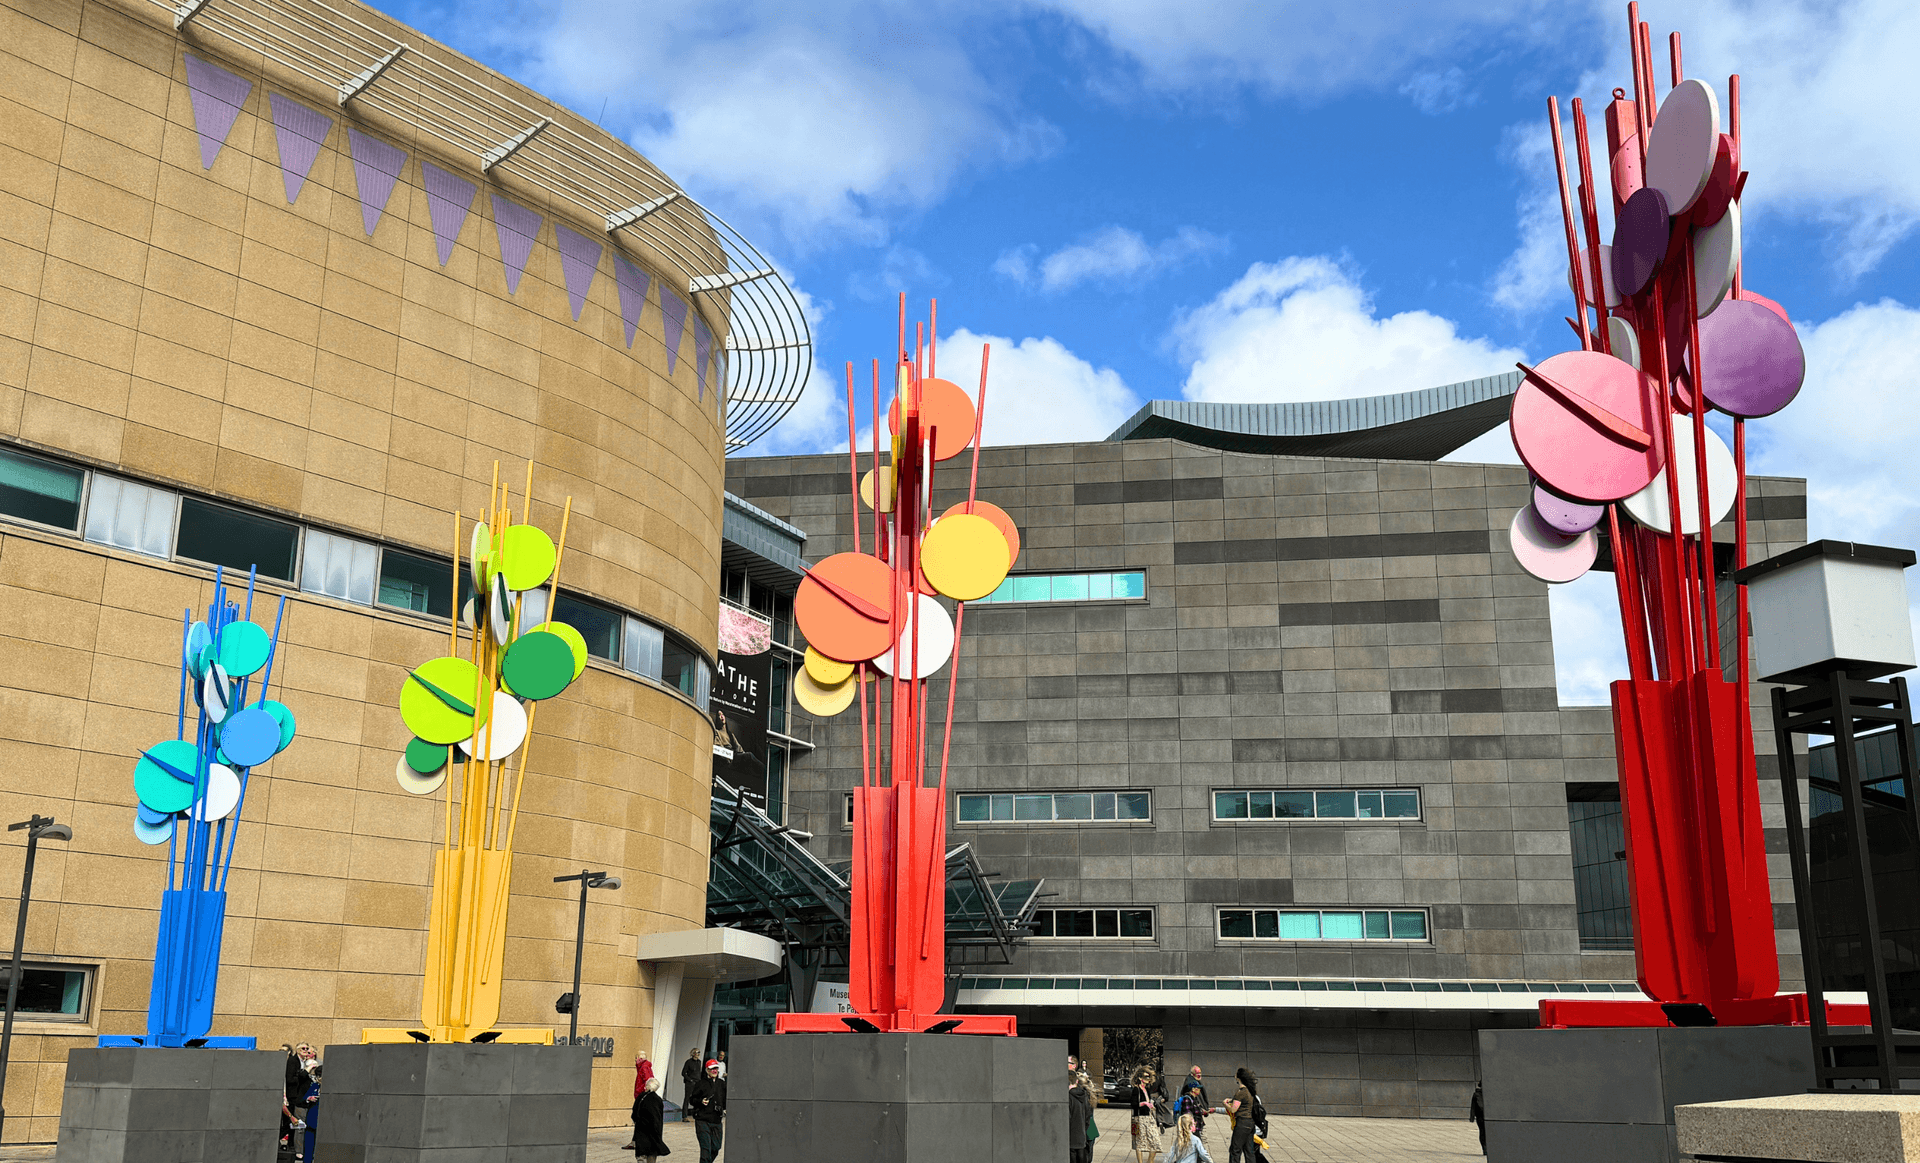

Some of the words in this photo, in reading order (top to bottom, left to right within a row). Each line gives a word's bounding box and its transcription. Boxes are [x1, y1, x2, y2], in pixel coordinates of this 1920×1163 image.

[838, 1003, 846, 1013] Te
[846, 1003, 857, 1014] Pa
[574, 1032, 615, 1054] store
